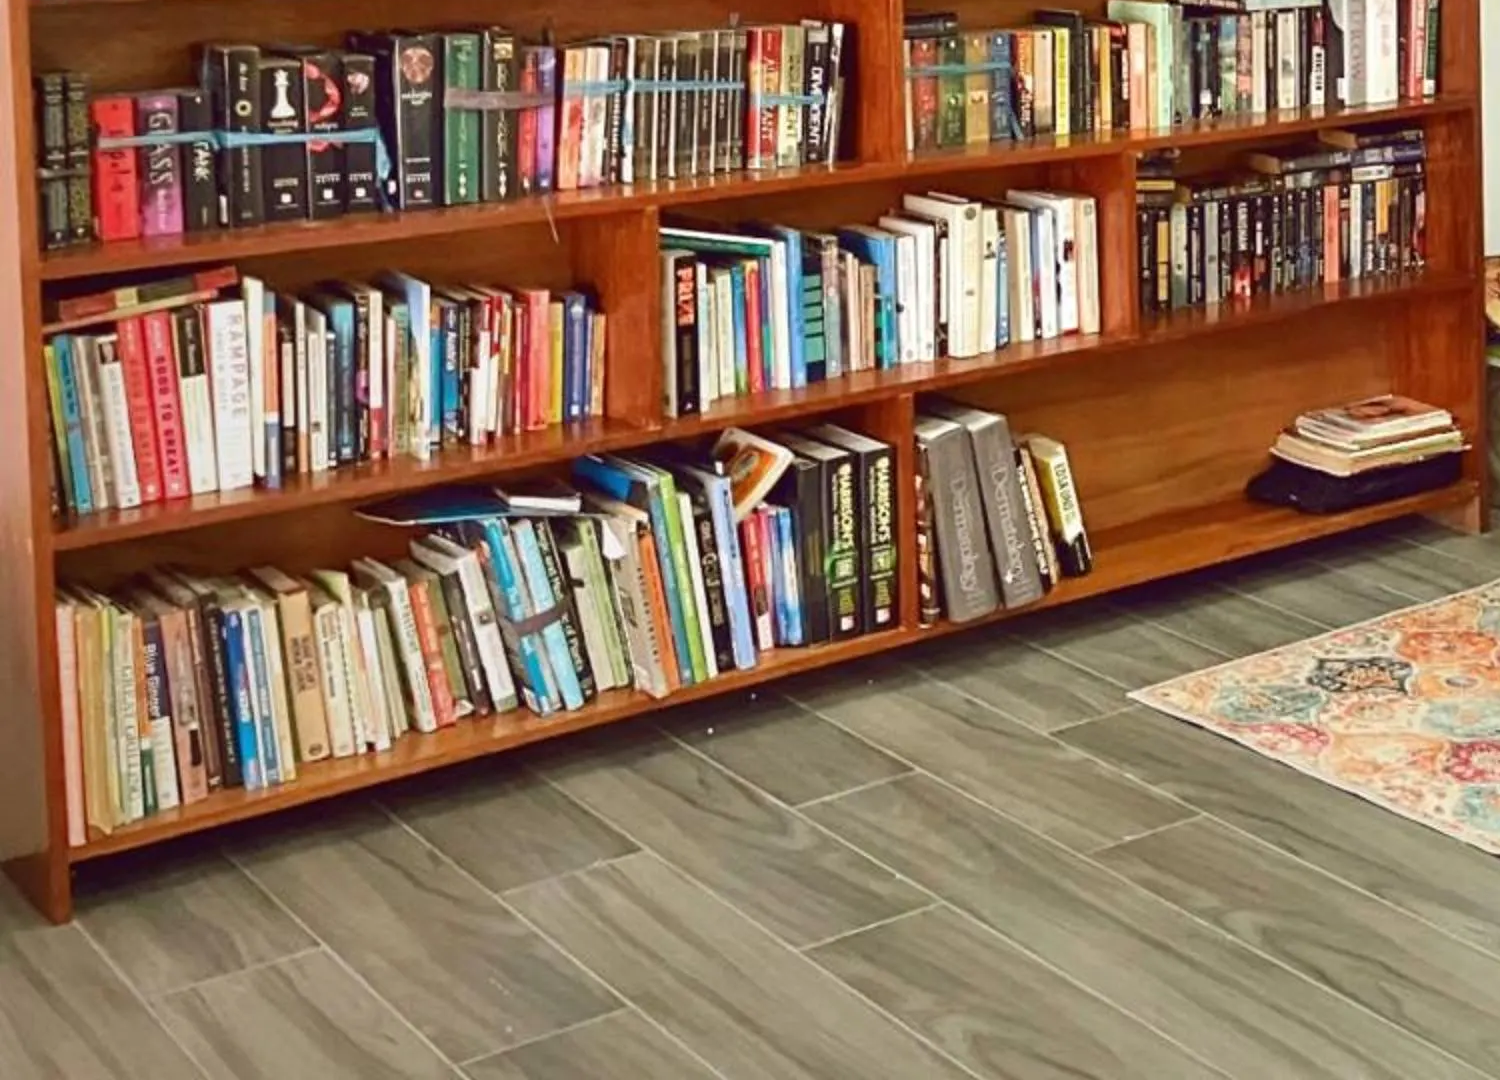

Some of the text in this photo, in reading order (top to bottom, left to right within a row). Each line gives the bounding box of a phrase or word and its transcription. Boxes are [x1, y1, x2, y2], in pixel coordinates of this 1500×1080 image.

[228, 314, 247, 419] RAMPAGE
[951, 476, 978, 592] Dermatology
[991, 461, 1023, 585] Dermatology
